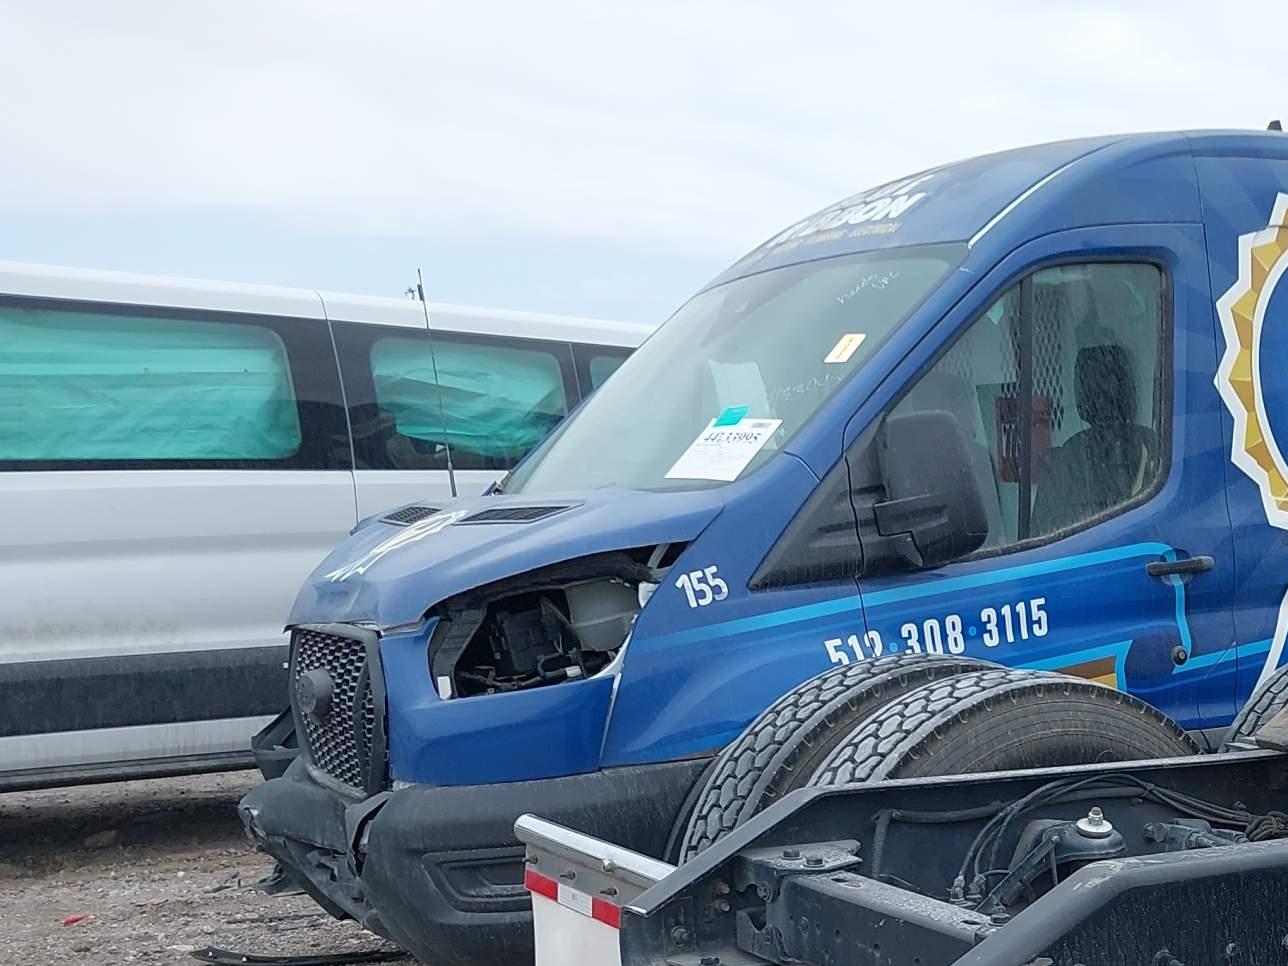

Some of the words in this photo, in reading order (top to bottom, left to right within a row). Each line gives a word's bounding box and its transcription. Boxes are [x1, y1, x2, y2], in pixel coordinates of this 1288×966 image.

[674, 564, 729, 609] 155
[824, 629, 884, 665] 512
[900, 614, 966, 656] 308
[980, 597, 1049, 648] 3115
